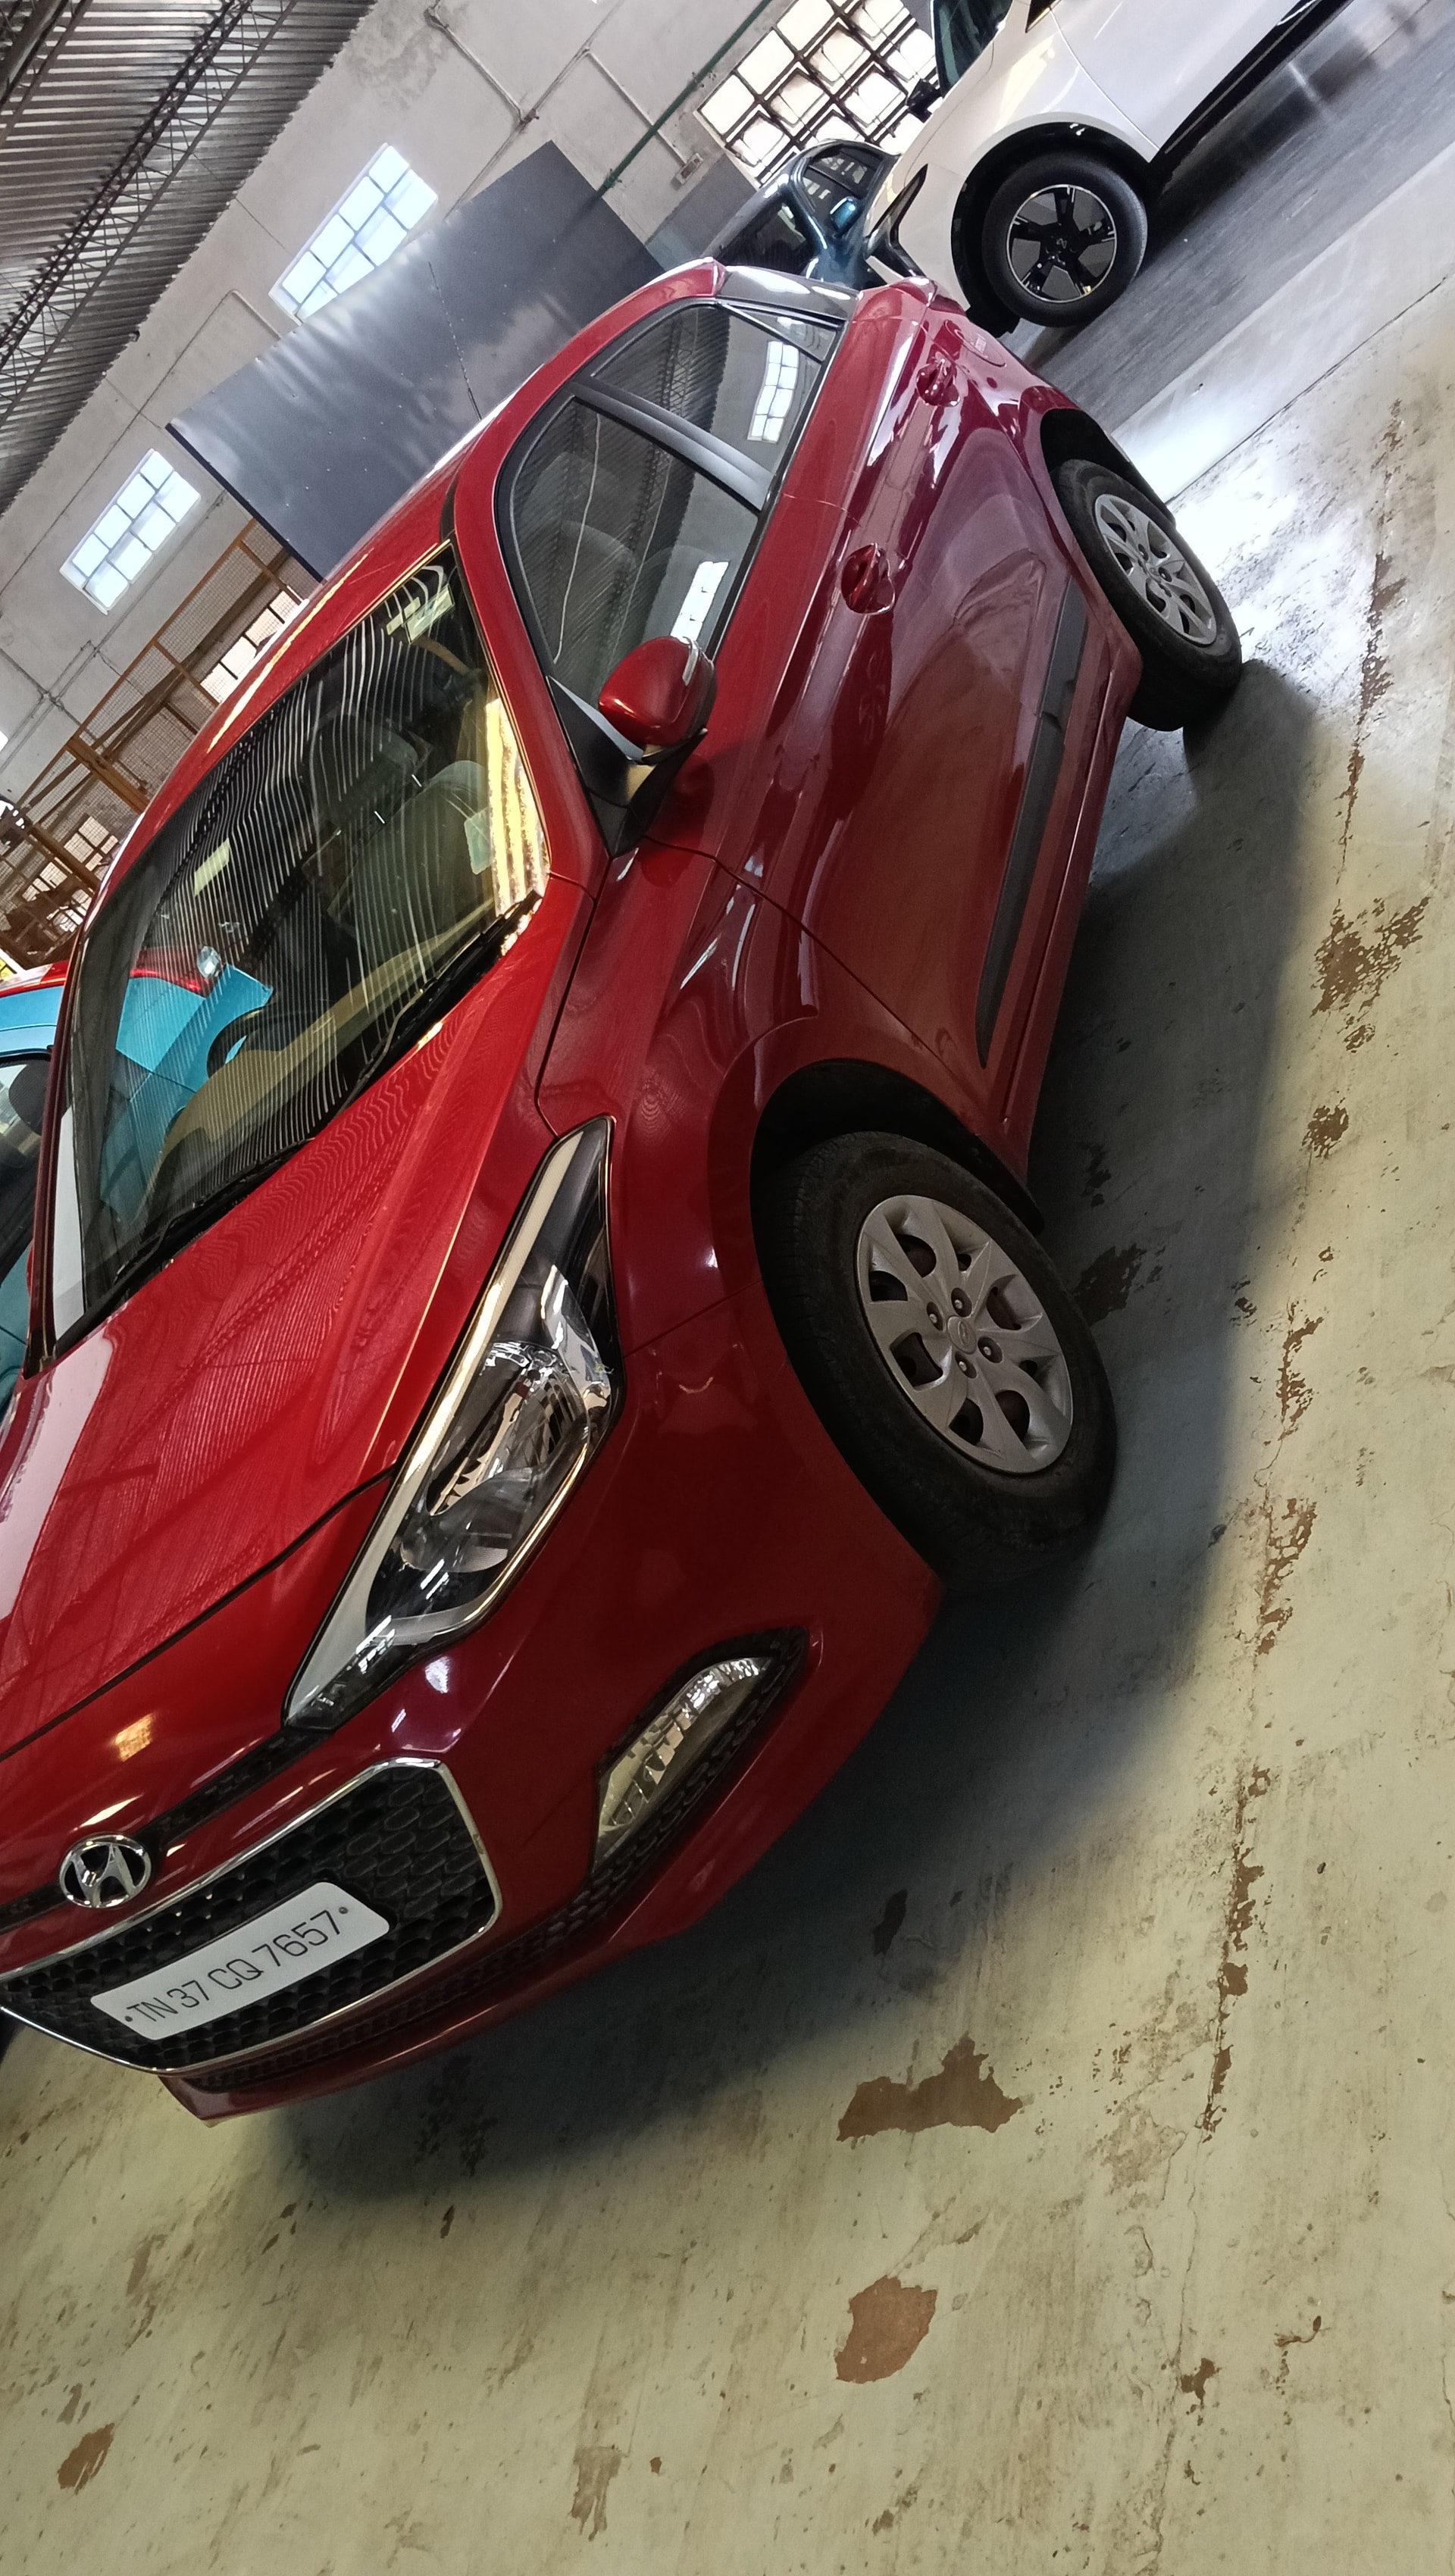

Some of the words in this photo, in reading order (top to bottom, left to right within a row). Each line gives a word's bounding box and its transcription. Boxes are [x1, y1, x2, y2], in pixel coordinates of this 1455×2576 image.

[126, 1996, 178, 2022] TN
[167, 1980, 210, 2008] 37
[208, 1959, 264, 1990] CQ
[251, 1909, 341, 1968] 7657
